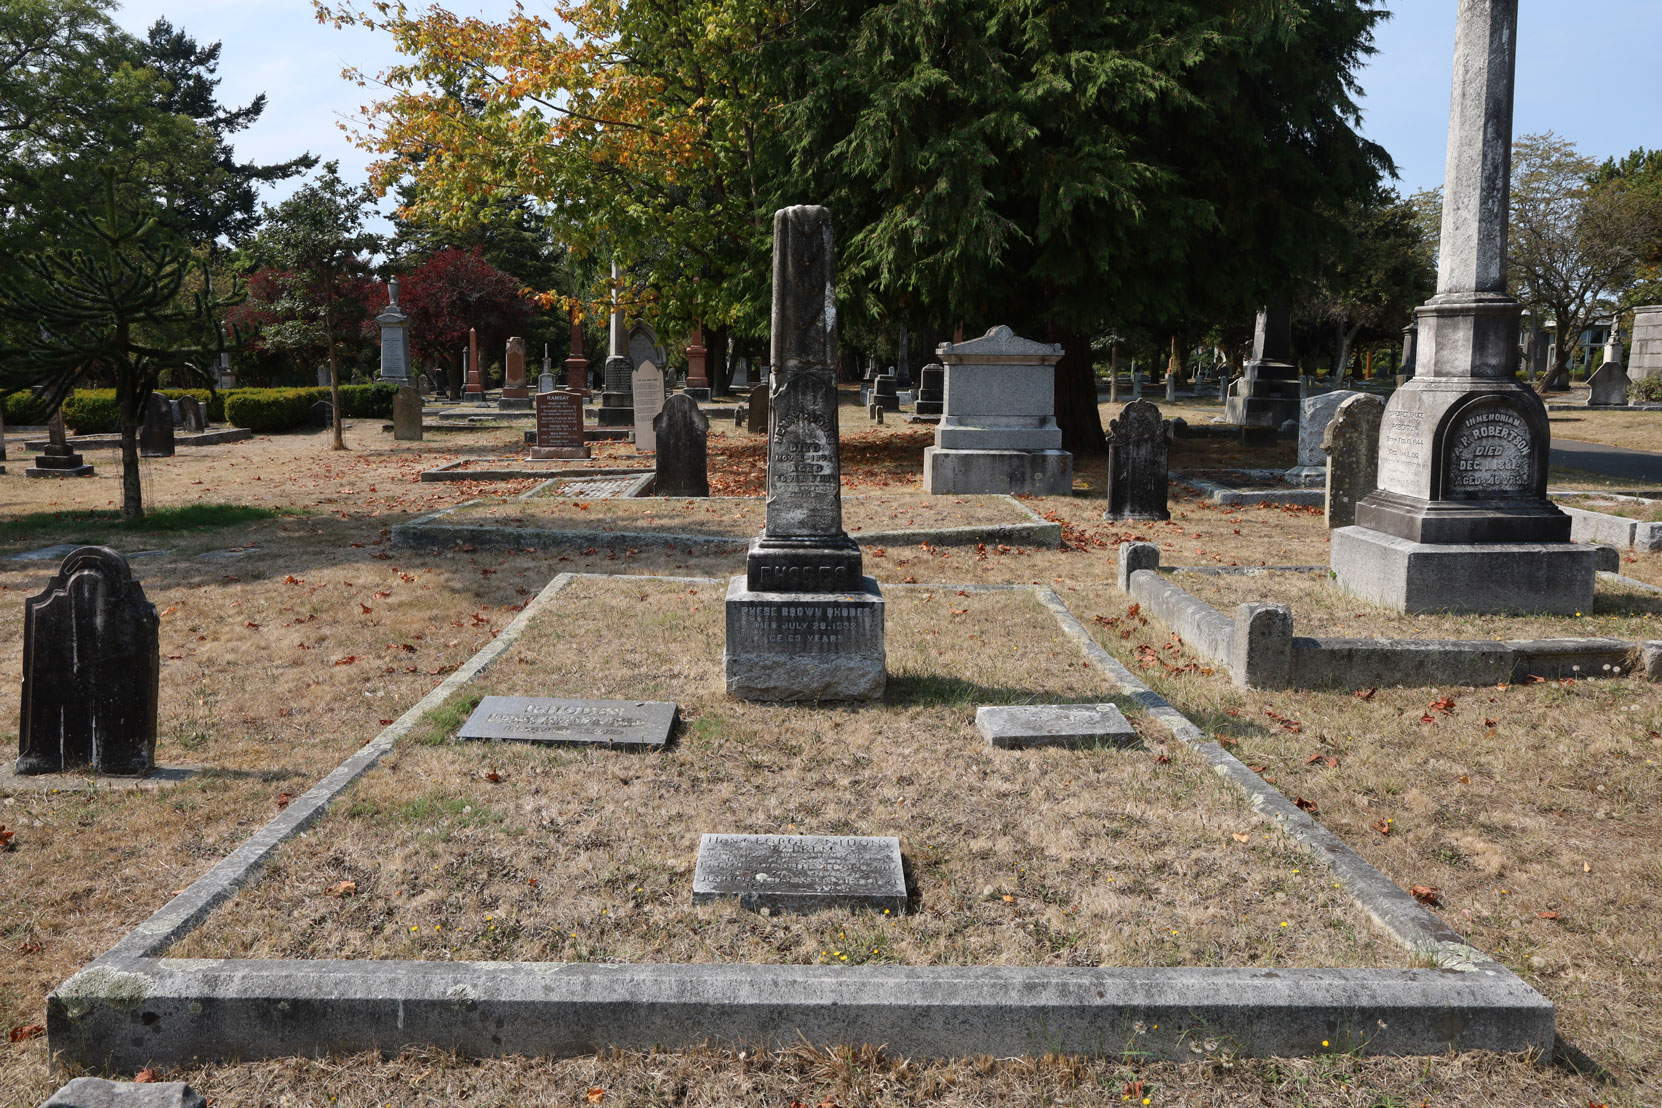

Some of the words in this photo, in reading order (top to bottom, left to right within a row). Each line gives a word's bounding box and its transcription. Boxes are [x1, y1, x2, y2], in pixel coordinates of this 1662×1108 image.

[1465, 418, 1476, 428] IN
[1476, 413, 1521, 427] MEMORIAM
[1472, 426, 1531, 456] ROBERTSON
[789, 442, 820, 452] DIED
[1475, 446, 1503, 456] DIED
[790, 464, 824, 473] AGED
[1459, 460, 1482, 470] DEC.
[1454, 476, 1481, 485] AGED
[760, 566, 847, 584] RHODES
[741, 607, 777, 617] PHEBE
[781, 607, 822, 617] BROWN
[827, 607, 871, 618] RHODES
[753, 621, 777, 630] DIED
[782, 621, 808, 630] JULY
[788, 634, 801, 643] 63
[807, 634, 844, 643] YEARS
[814, 838, 893, 847] ANTHONY
